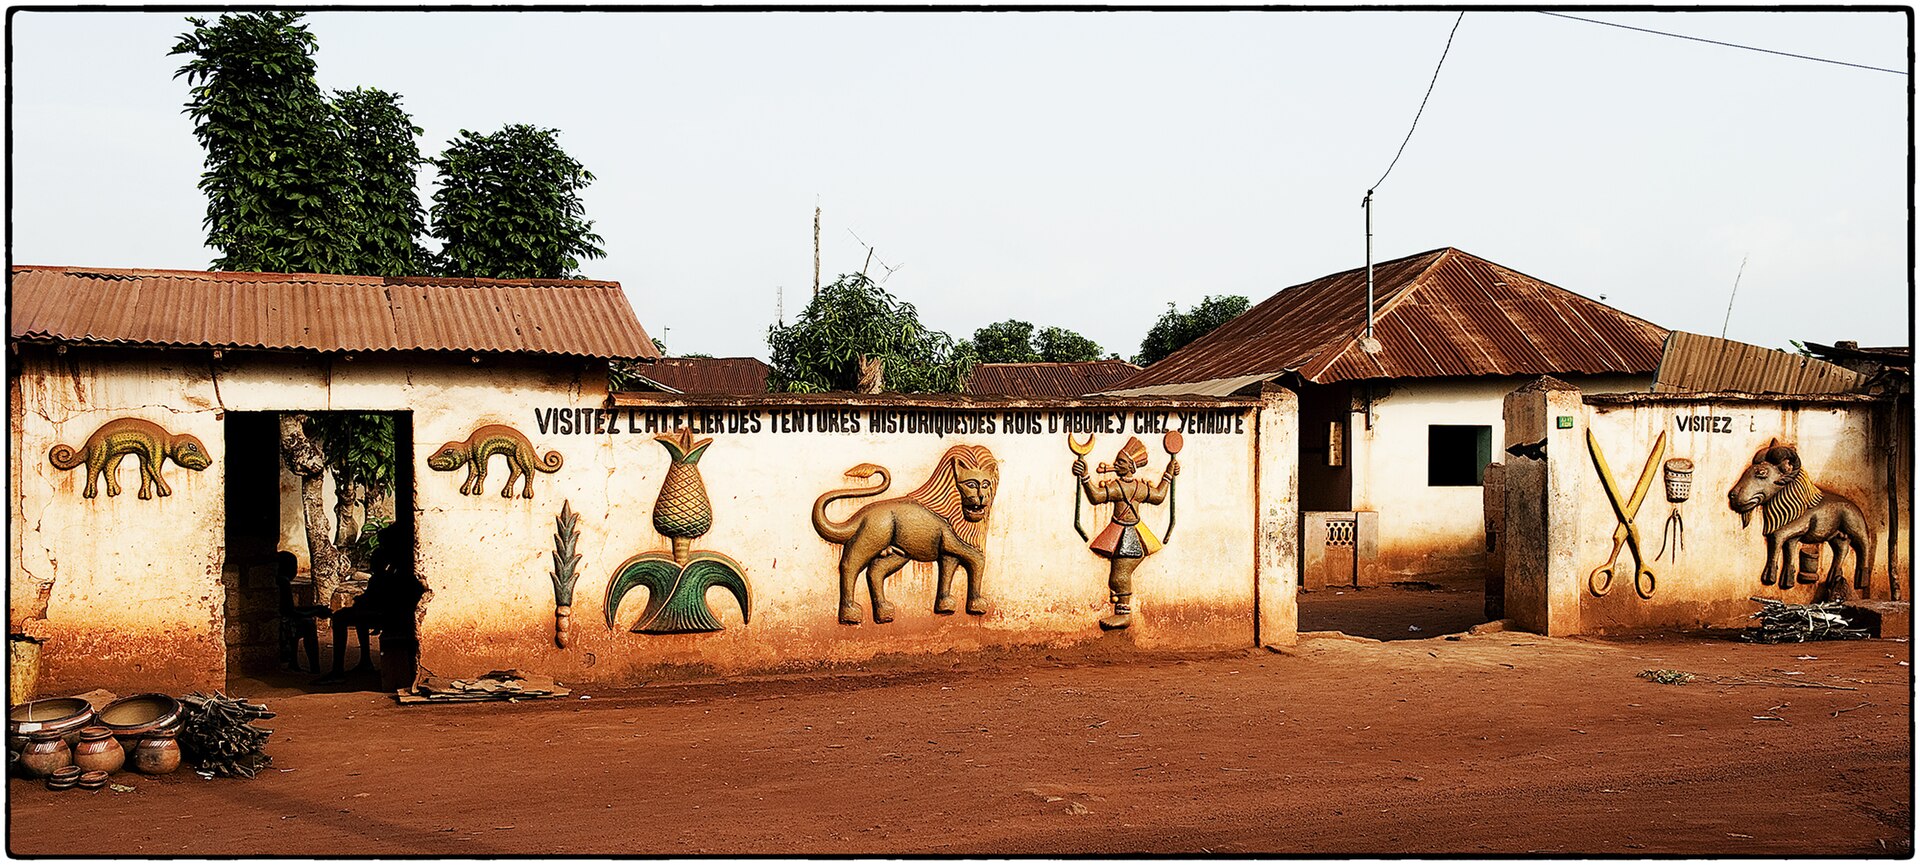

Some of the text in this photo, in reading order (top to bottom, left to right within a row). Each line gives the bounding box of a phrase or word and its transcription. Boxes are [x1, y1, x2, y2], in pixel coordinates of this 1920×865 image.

[535, 407, 621, 435] VISITEZ
[628, 408, 725, 434] L'ATELIER
[728, 409, 762, 434] DES
[768, 409, 861, 434] TENTURES
[868, 409, 967, 439] HISTORIQUES
[968, 410, 996, 434] DES
[1002, 410, 1042, 435] ROIS
[1133, 410, 1170, 435] CHEZ
[1675, 414, 1732, 434] VISITEZ
